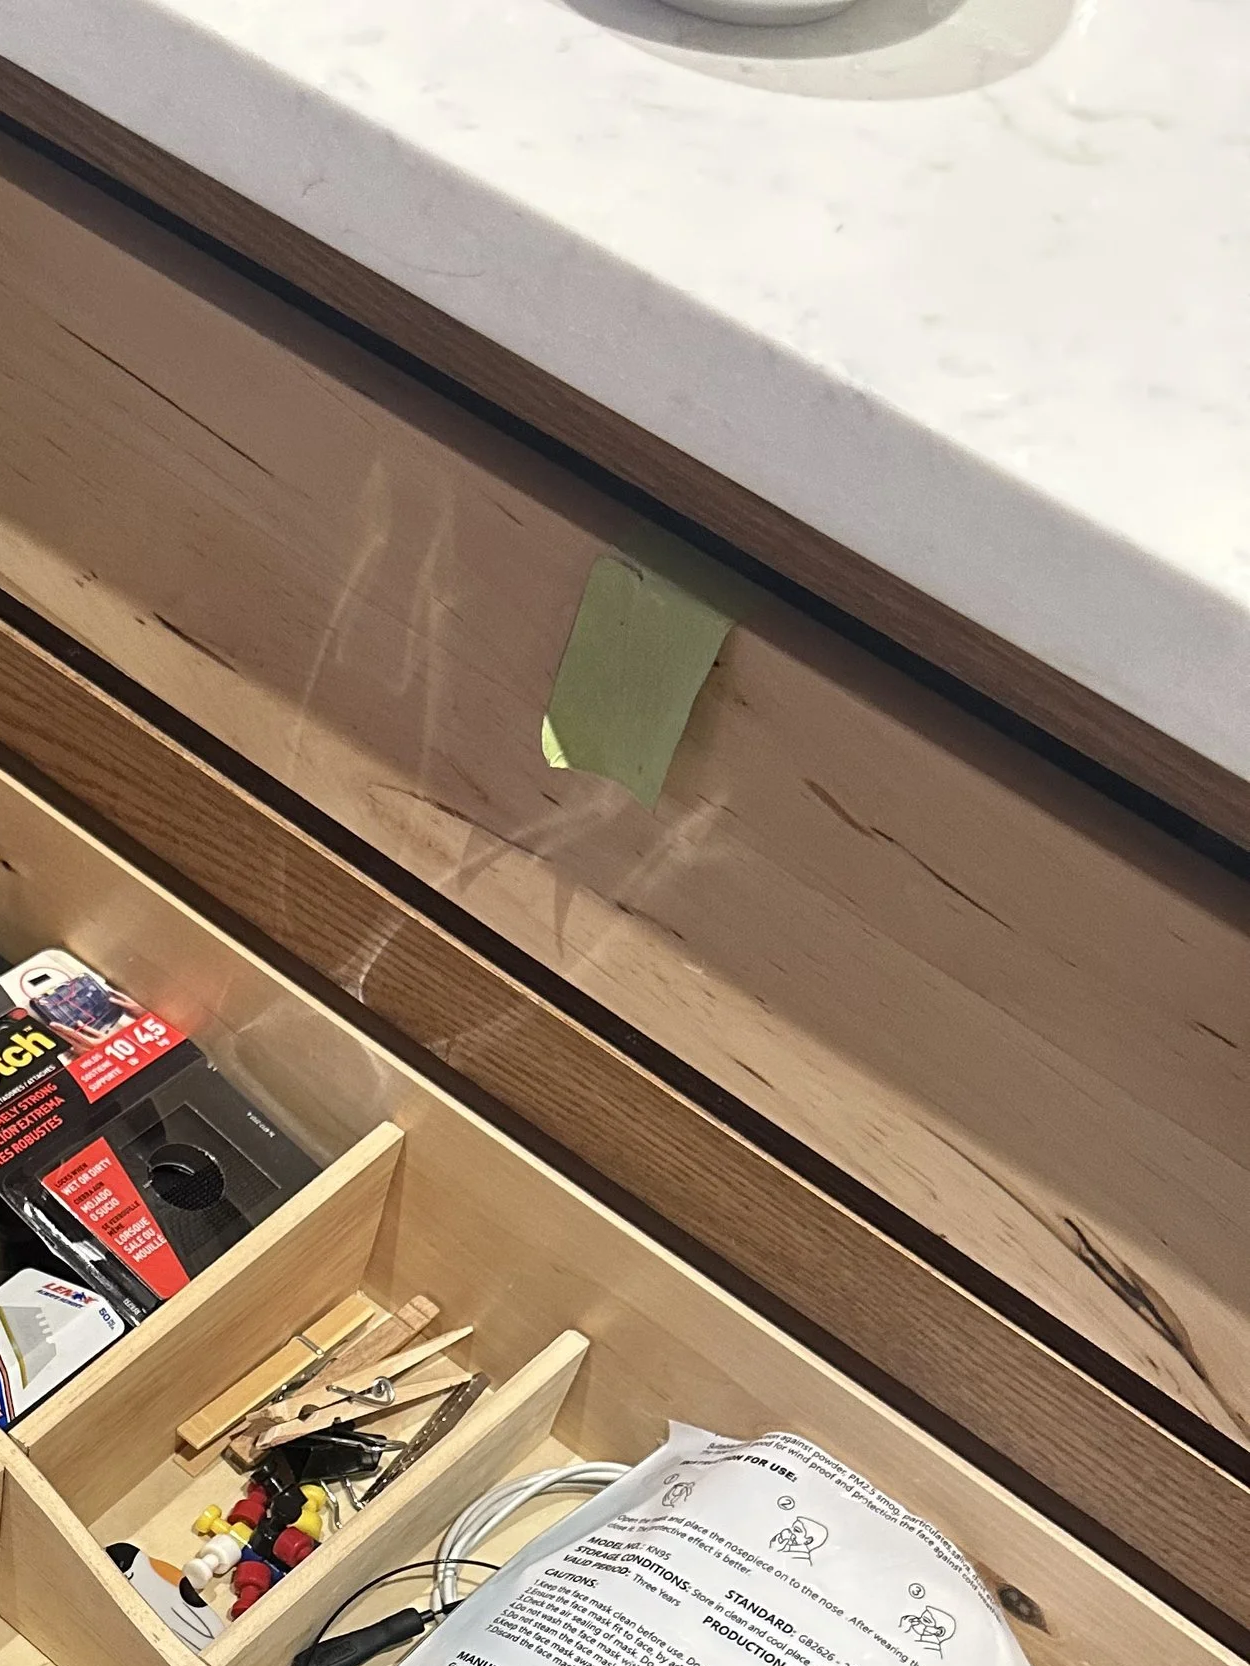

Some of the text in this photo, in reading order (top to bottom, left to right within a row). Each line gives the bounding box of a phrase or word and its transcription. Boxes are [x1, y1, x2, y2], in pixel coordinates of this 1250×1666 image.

[104, 1039, 136, 1061] 10
[18, 1082, 56, 1109] STRONG
[16, 1095, 64, 1129] EXTREMA
[11, 1115, 63, 1152] ROBUSTES
[62, 1159, 110, 1195] WET OR DIRTY
[81, 1190, 112, 1212] MOJADO
[90, 1199, 118, 1221] O SUCIO
[114, 1218, 150, 1244] LORSQUE
[124, 1228, 155, 1253] SALE OU
[132, 1235, 166, 1261] MOUILLÉ
[742, 1454, 797, 1482] FOR USE:
[645, 1544, 672, 1560] KN95
[632, 1572, 657, 1592] Three
[657, 1588, 681, 1606] Years
[690, 1588, 714, 1606] Store
[713, 1601, 724, 1612] in
[723, 1610, 748, 1627] clean
[747, 1624, 768, 1638] and
[765, 1635, 788, 1650] cool
[724, 1589, 797, 1637] STANDARD:
[797, 1634, 835, 1661] GB2626
